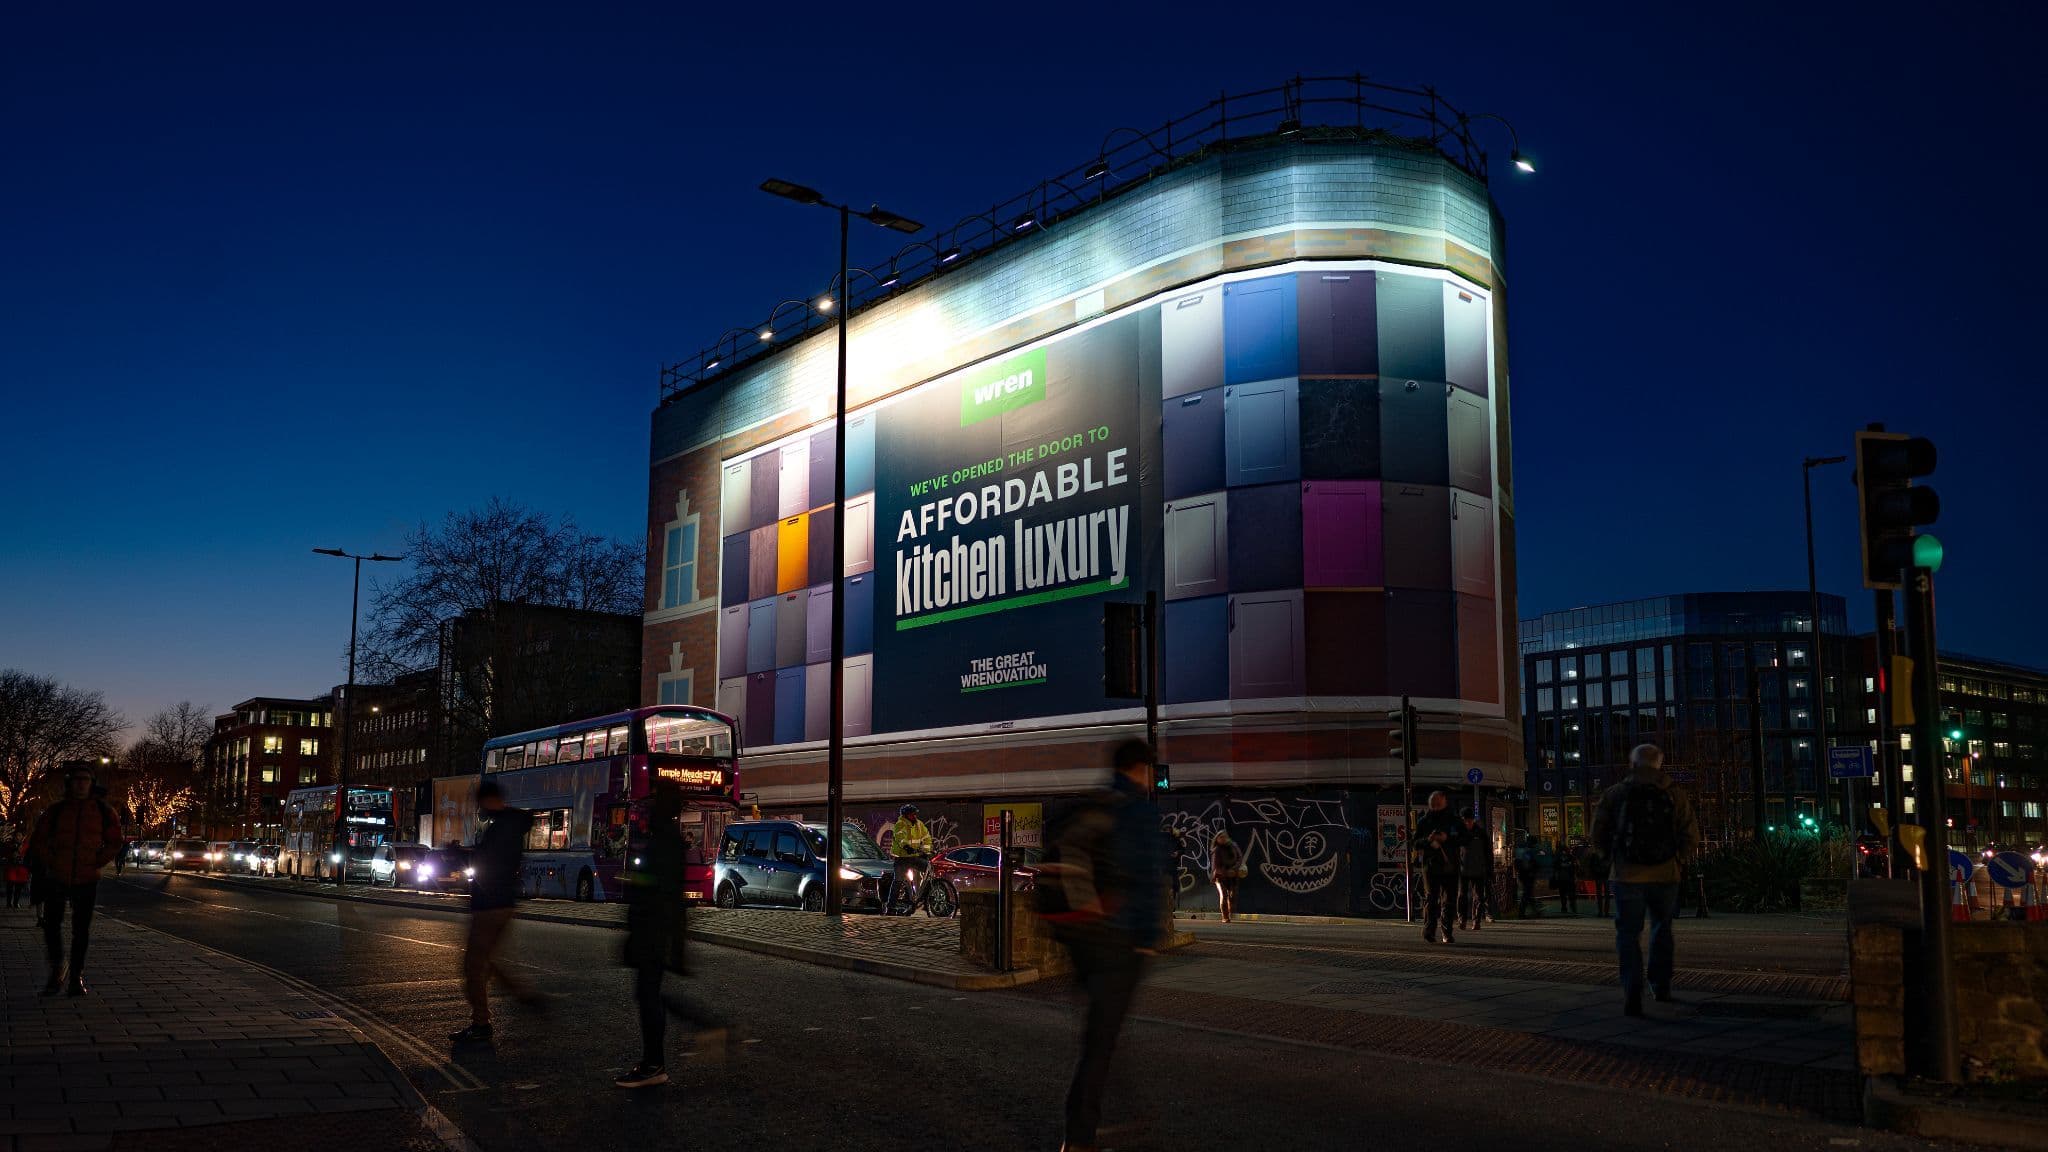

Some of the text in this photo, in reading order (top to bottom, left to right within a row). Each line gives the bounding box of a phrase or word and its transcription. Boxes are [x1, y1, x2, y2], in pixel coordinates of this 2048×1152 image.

[975, 367, 1033, 406] wren
[910, 426, 1109, 497] WE'VE OPENED THE DOOR TO
[897, 447, 1128, 543] AFFORDABLE
[896, 504, 1129, 616] kitchen luxury
[961, 663, 1047, 688] WRENOVATION
[970, 651, 1035, 673] THE GREAT
[658, 767, 722, 785] Temple Meads 74
